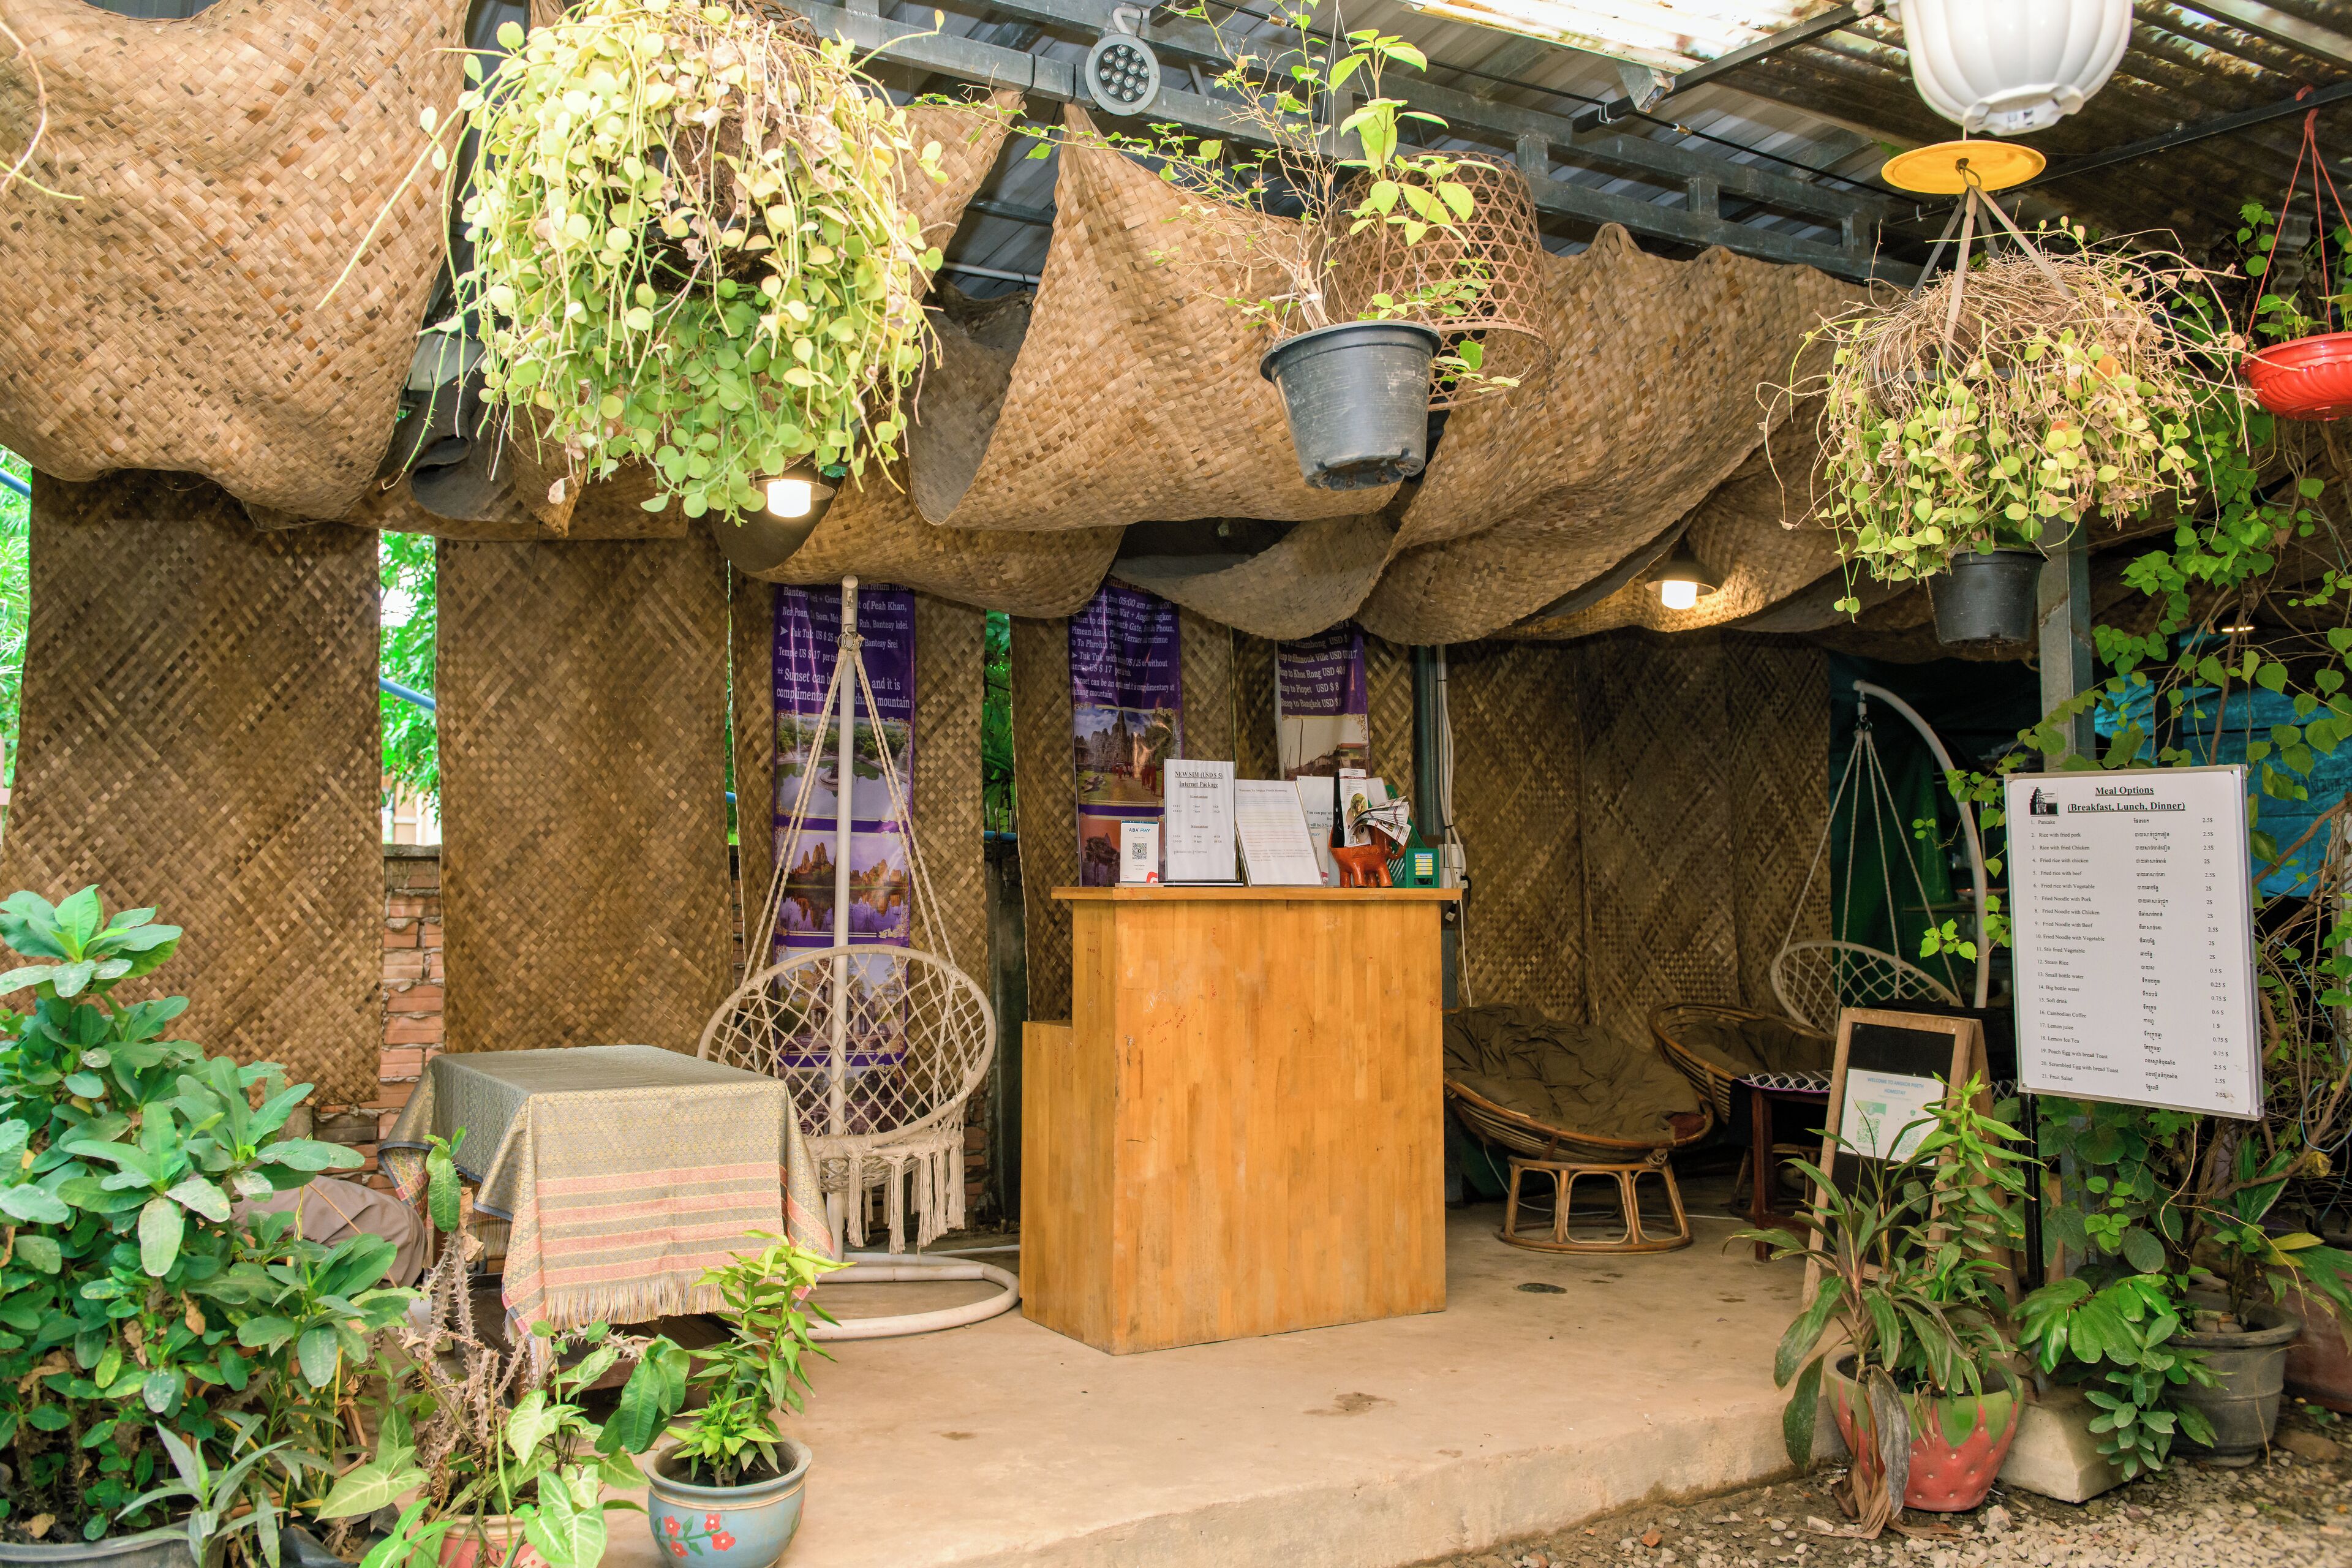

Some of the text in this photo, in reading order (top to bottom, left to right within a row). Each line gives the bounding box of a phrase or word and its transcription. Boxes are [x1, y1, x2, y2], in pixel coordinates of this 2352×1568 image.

[784, 587, 809, 600] Banteay
[863, 600, 870, 611] of
[871, 601, 886, 610] Peah
[888, 601, 907, 612] Khan,
[1118, 597, 1136, 606] 05:00
[794, 608, 809, 619] Poan,
[873, 620, 894, 631] Banteay
[1071, 626, 1091, 636] Pimean
[1156, 624, 1174, 633] Phoun,
[802, 628, 898, 650] Tuk US Banteay Srei
[778, 646, 820, 659] Temple US 17
[1330, 650, 1341, 660] USD
[1306, 667, 1334, 679] Rong USD
[785, 668, 900, 690] Sunset can and it is
[1074, 676, 1089, 685] Sunset
[1316, 682, 1339, 693] USD 8
[877, 696, 910, 708] mountain
[2095, 786, 2154, 795] Meal Options
[2068, 801, 2185, 812] (Breakfast, Lunch, Dinner)
